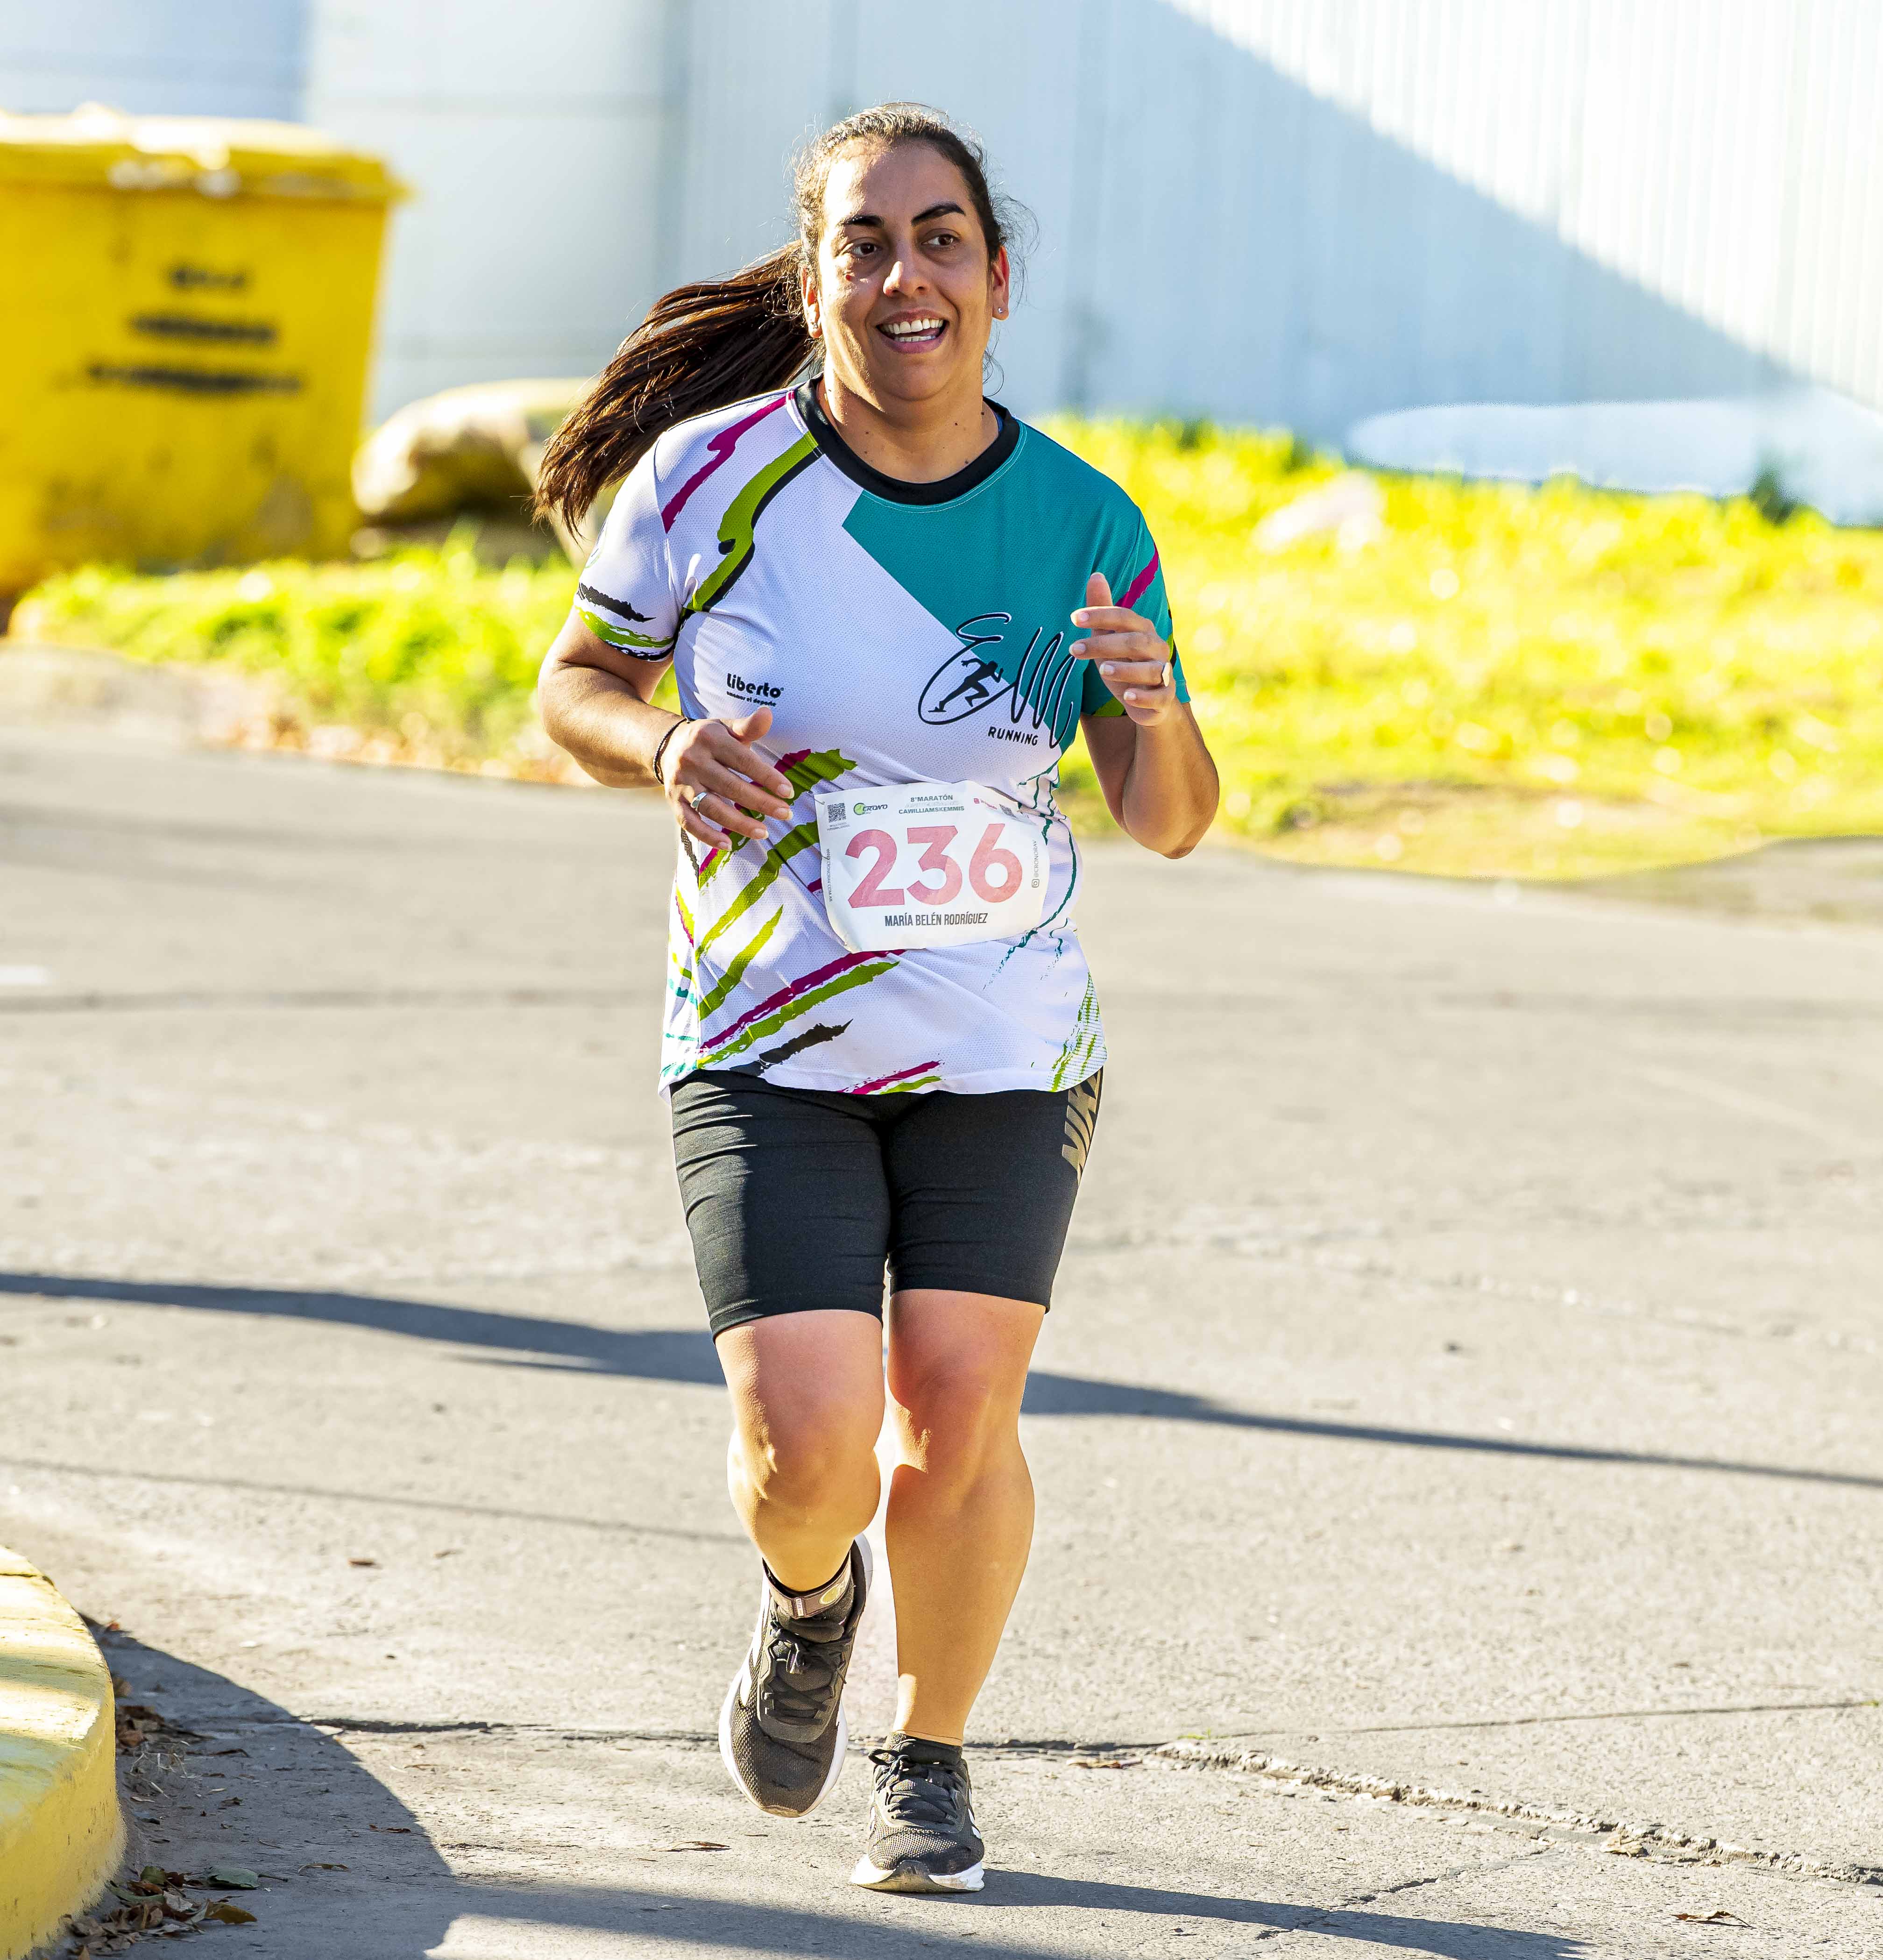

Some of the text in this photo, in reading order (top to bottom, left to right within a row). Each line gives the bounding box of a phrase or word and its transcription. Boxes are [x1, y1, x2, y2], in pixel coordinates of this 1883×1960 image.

[988, 726, 1039, 746] RUNNING
[845, 824, 1022, 908] 236
[885, 911, 988, 926] MARÍA BELÉN RODRÍGUEZ
